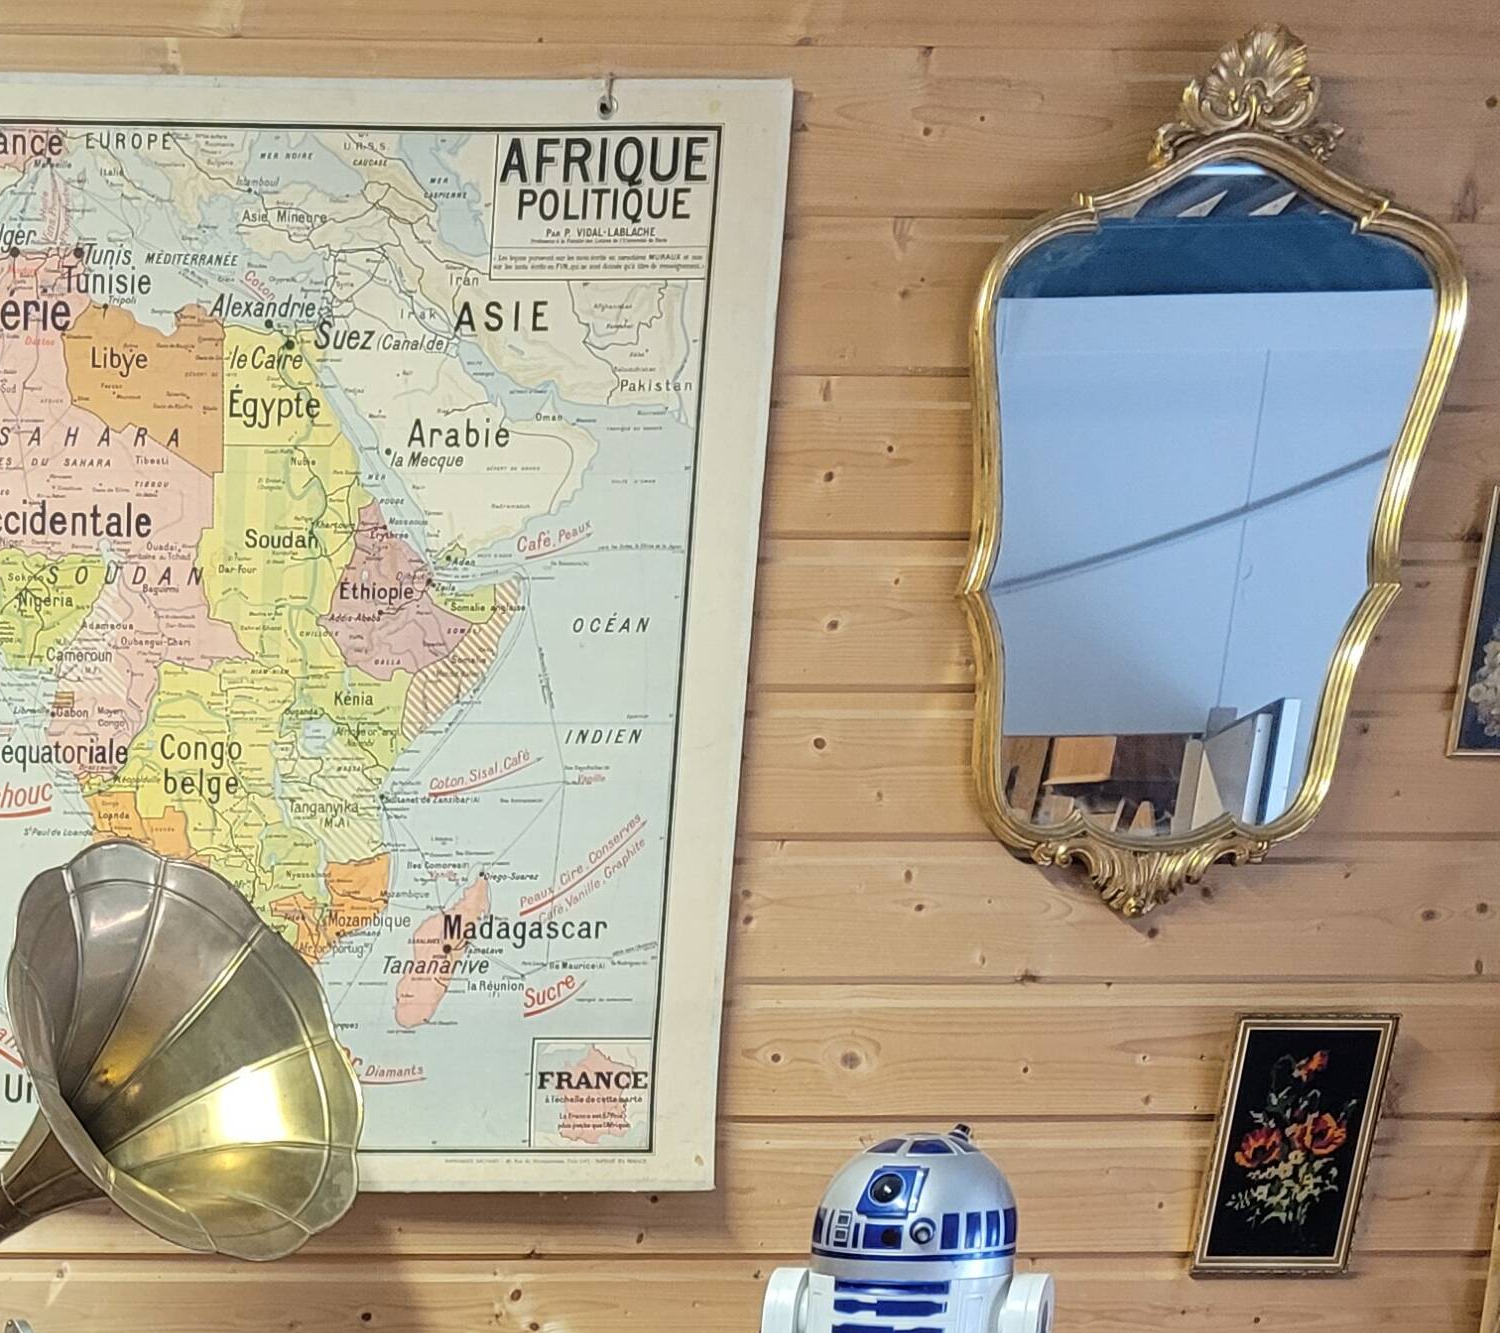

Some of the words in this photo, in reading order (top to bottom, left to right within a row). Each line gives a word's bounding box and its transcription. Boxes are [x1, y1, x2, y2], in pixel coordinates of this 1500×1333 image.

[85, 132, 172, 150] EUROPE
[500, 136, 710, 187] AFRIQUE
[517, 187, 692, 224] POLITIQUE
[242, 210, 268, 223] Asie
[276, 210, 328, 224] Mineure
[577, 227, 656, 237] VIDAL-LABLACHE
[82, 242, 132, 266] Tunis
[145, 252, 239, 267] MÉDITERRANÉE
[62, 266, 151, 294] Tunisie
[449, 274, 479, 288] Iran
[108, 295, 137, 306] Tripoli
[209, 293, 317, 319] Alexandrie
[400, 308, 437, 320] Irak
[454, 300, 550, 332] ASIE
[314, 320, 375, 350] Suez
[91, 346, 148, 378] Libye
[229, 346, 249, 369] le
[251, 347, 302, 369] Caire
[1, 383, 17, 393] Sud
[620, 379, 693, 394] Pakistan
[229, 384, 321, 428] Égypte
[535, 412, 563, 423] Oman
[407, 417, 510, 448] Arabie
[31, 458, 49, 466] DU
[63, 459, 112, 468] SAHARA
[389, 451, 405, 468] la
[407, 451, 464, 476] Mecque
[245, 529, 318, 549] Soudan
[558, 520, 592, 543] Peaux
[452, 559, 476, 567] Aden
[46, 564, 203, 586] SOUDAN
[340, 578, 414, 605] Éthiopie
[571, 614, 651, 634] OCÉAN
[46, 647, 112, 663] Cameroun
[334, 692, 373, 706] Kénia
[98, 719, 125, 729] Congo
[565, 729, 643, 744] INDIEN
[1, 736, 128, 773] équatoriale
[160, 734, 241, 770] Congo
[503, 750, 531, 769] Café
[163, 768, 239, 803] belge
[289, 800, 359, 816] Tanganyika
[519, 886, 554, 908] Peaux
[559, 861, 584, 886] Cire
[588, 813, 642, 865] Conserves
[603, 838, 646, 880] Graphite
[327, 911, 411, 933] Mozambique
[443, 914, 608, 949] Madagascar
[383, 955, 489, 974] Tananarive
[467, 982, 477, 991] la
[479, 981, 525, 992] Réunion
[524, 974, 576, 1008] Sucre
[365, 1065, 424, 1077] Diamants
[538, 1071, 648, 1089] FRANCE
